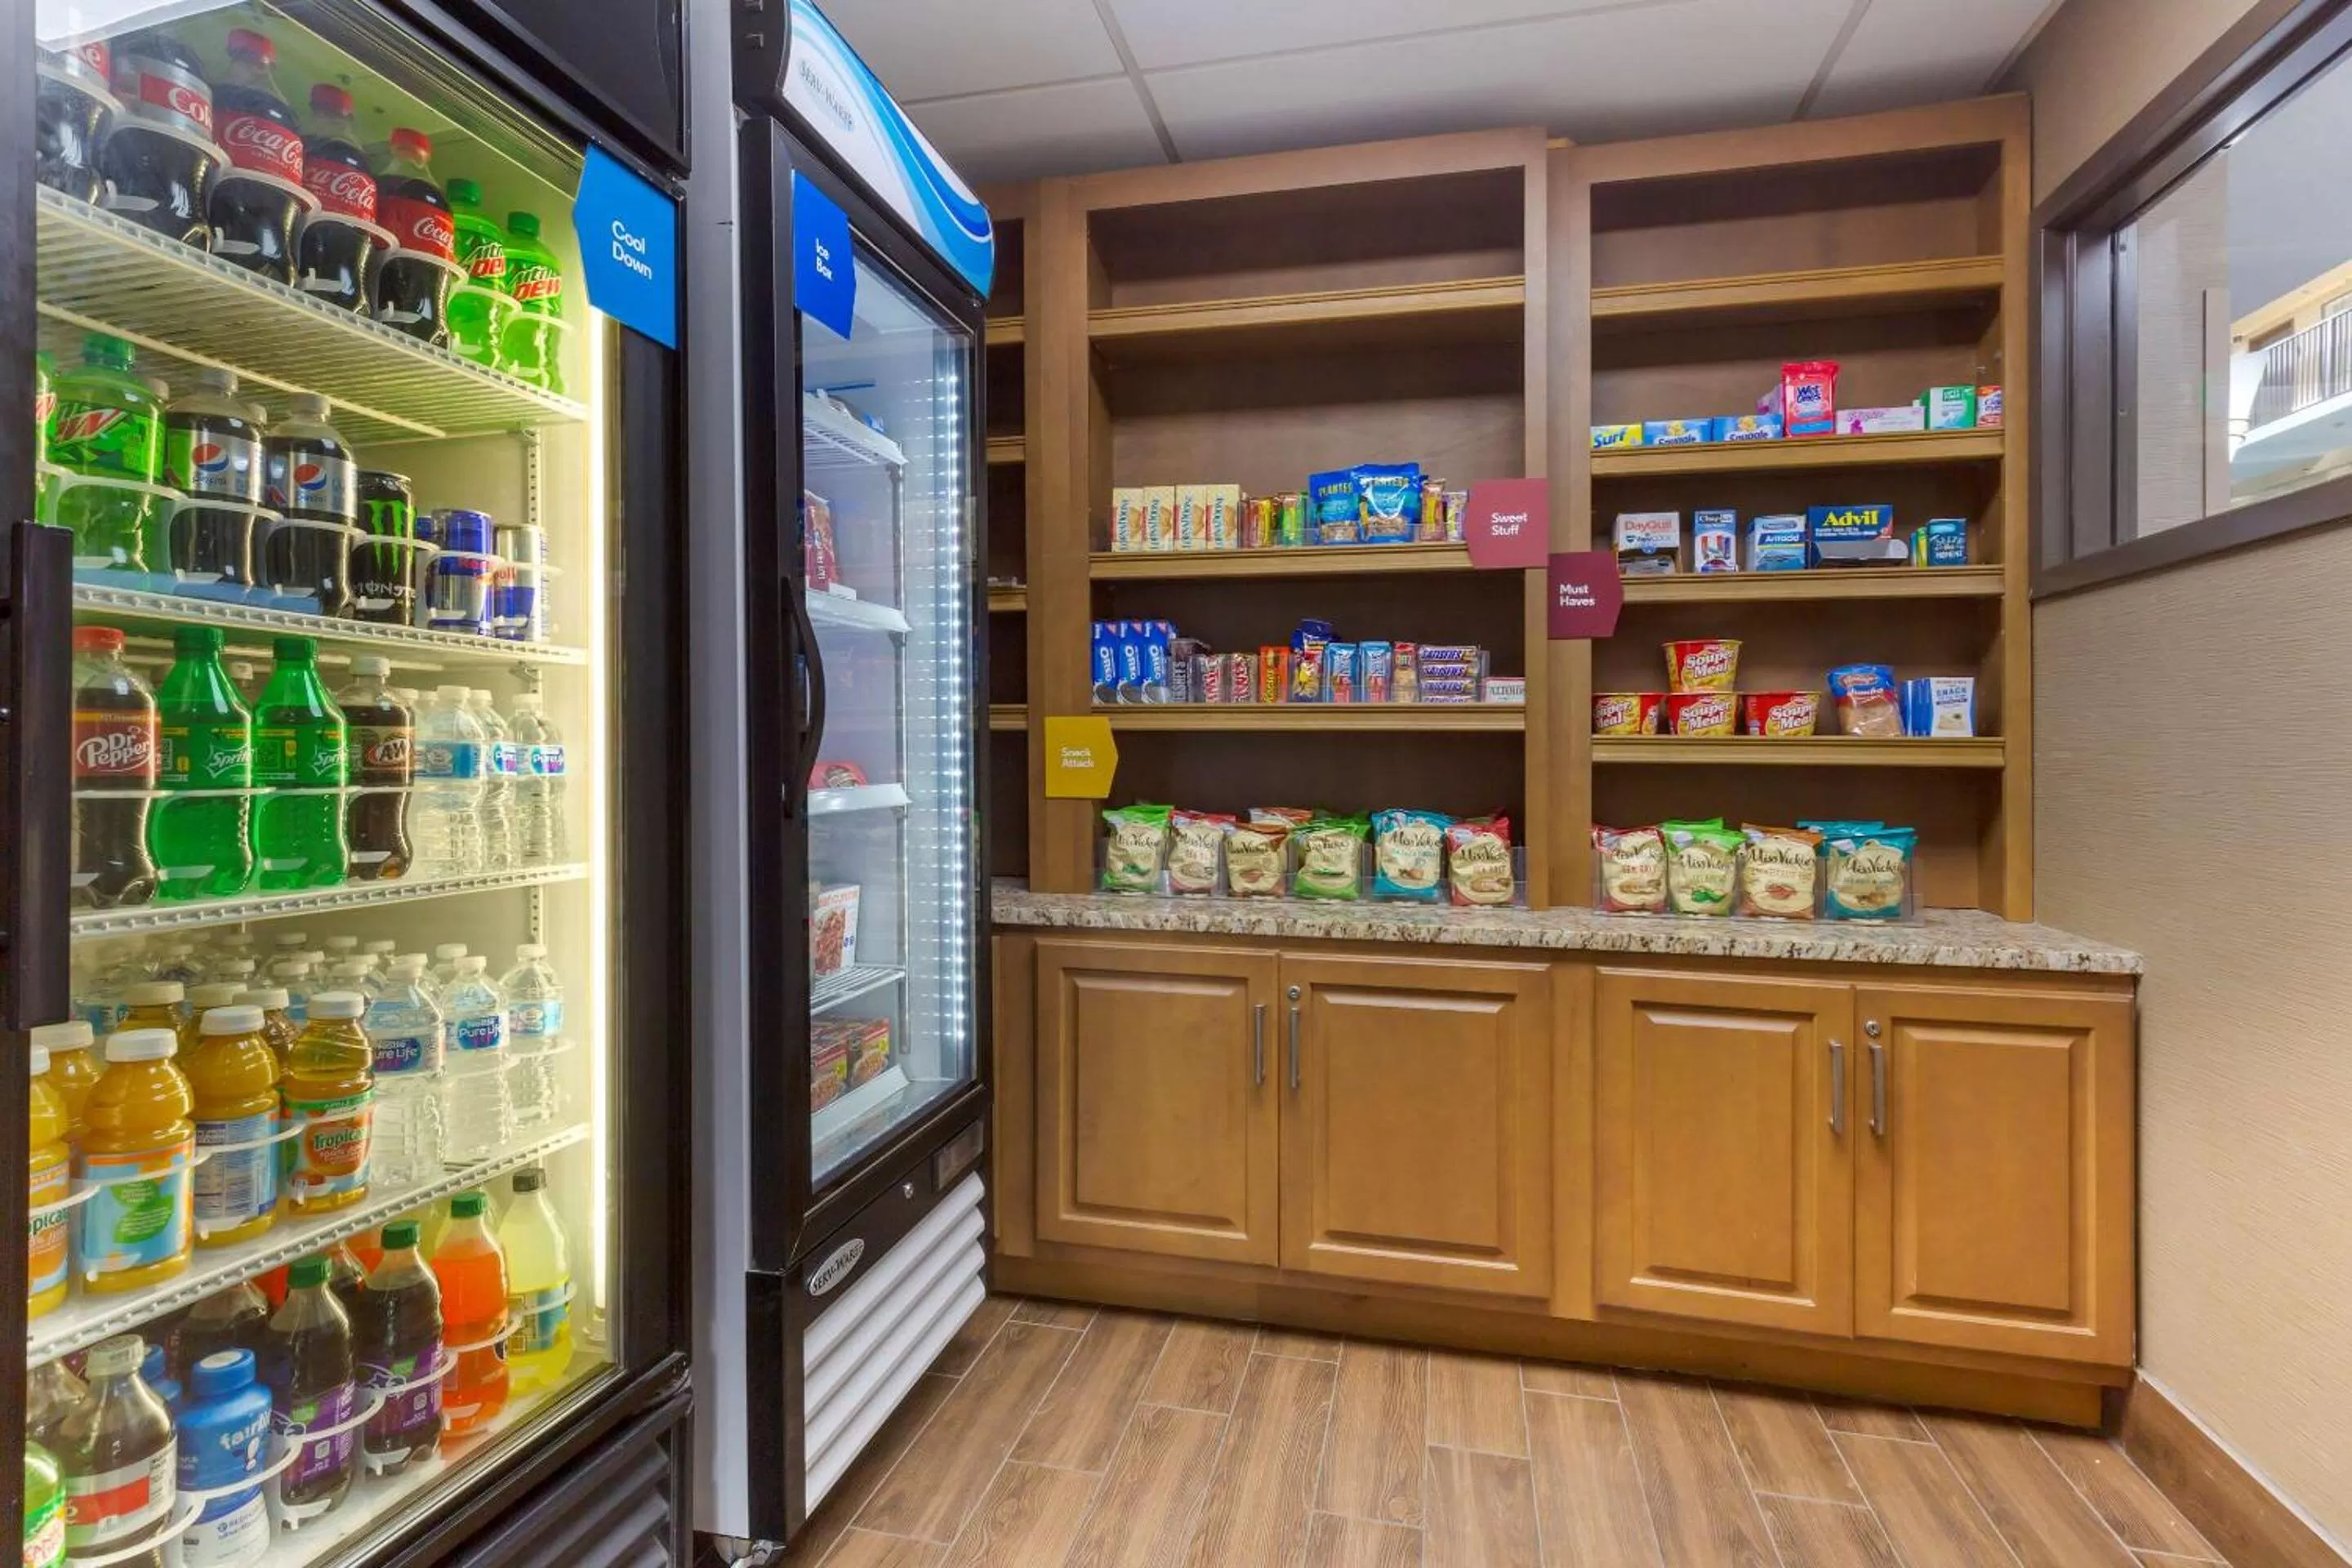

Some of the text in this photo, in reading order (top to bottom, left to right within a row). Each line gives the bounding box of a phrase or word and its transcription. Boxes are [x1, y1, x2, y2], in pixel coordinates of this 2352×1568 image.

[612, 220, 645, 255] Cool
[816, 238, 830, 261] Ice
[612, 241, 653, 279] Down
[816, 256, 833, 281] Box
[1593, 429, 1626, 449] Surf
[1491, 512, 1528, 523] Sweet
[1823, 510, 1878, 526] Advil
[1491, 524, 1520, 536] Stuff
[1560, 584, 1588, 595] Must
[1560, 596, 1595, 607] Haves
[109, 733, 135, 750] Dr
[87, 737, 150, 768] Pepper
[1062, 747, 1092, 756] Snack
